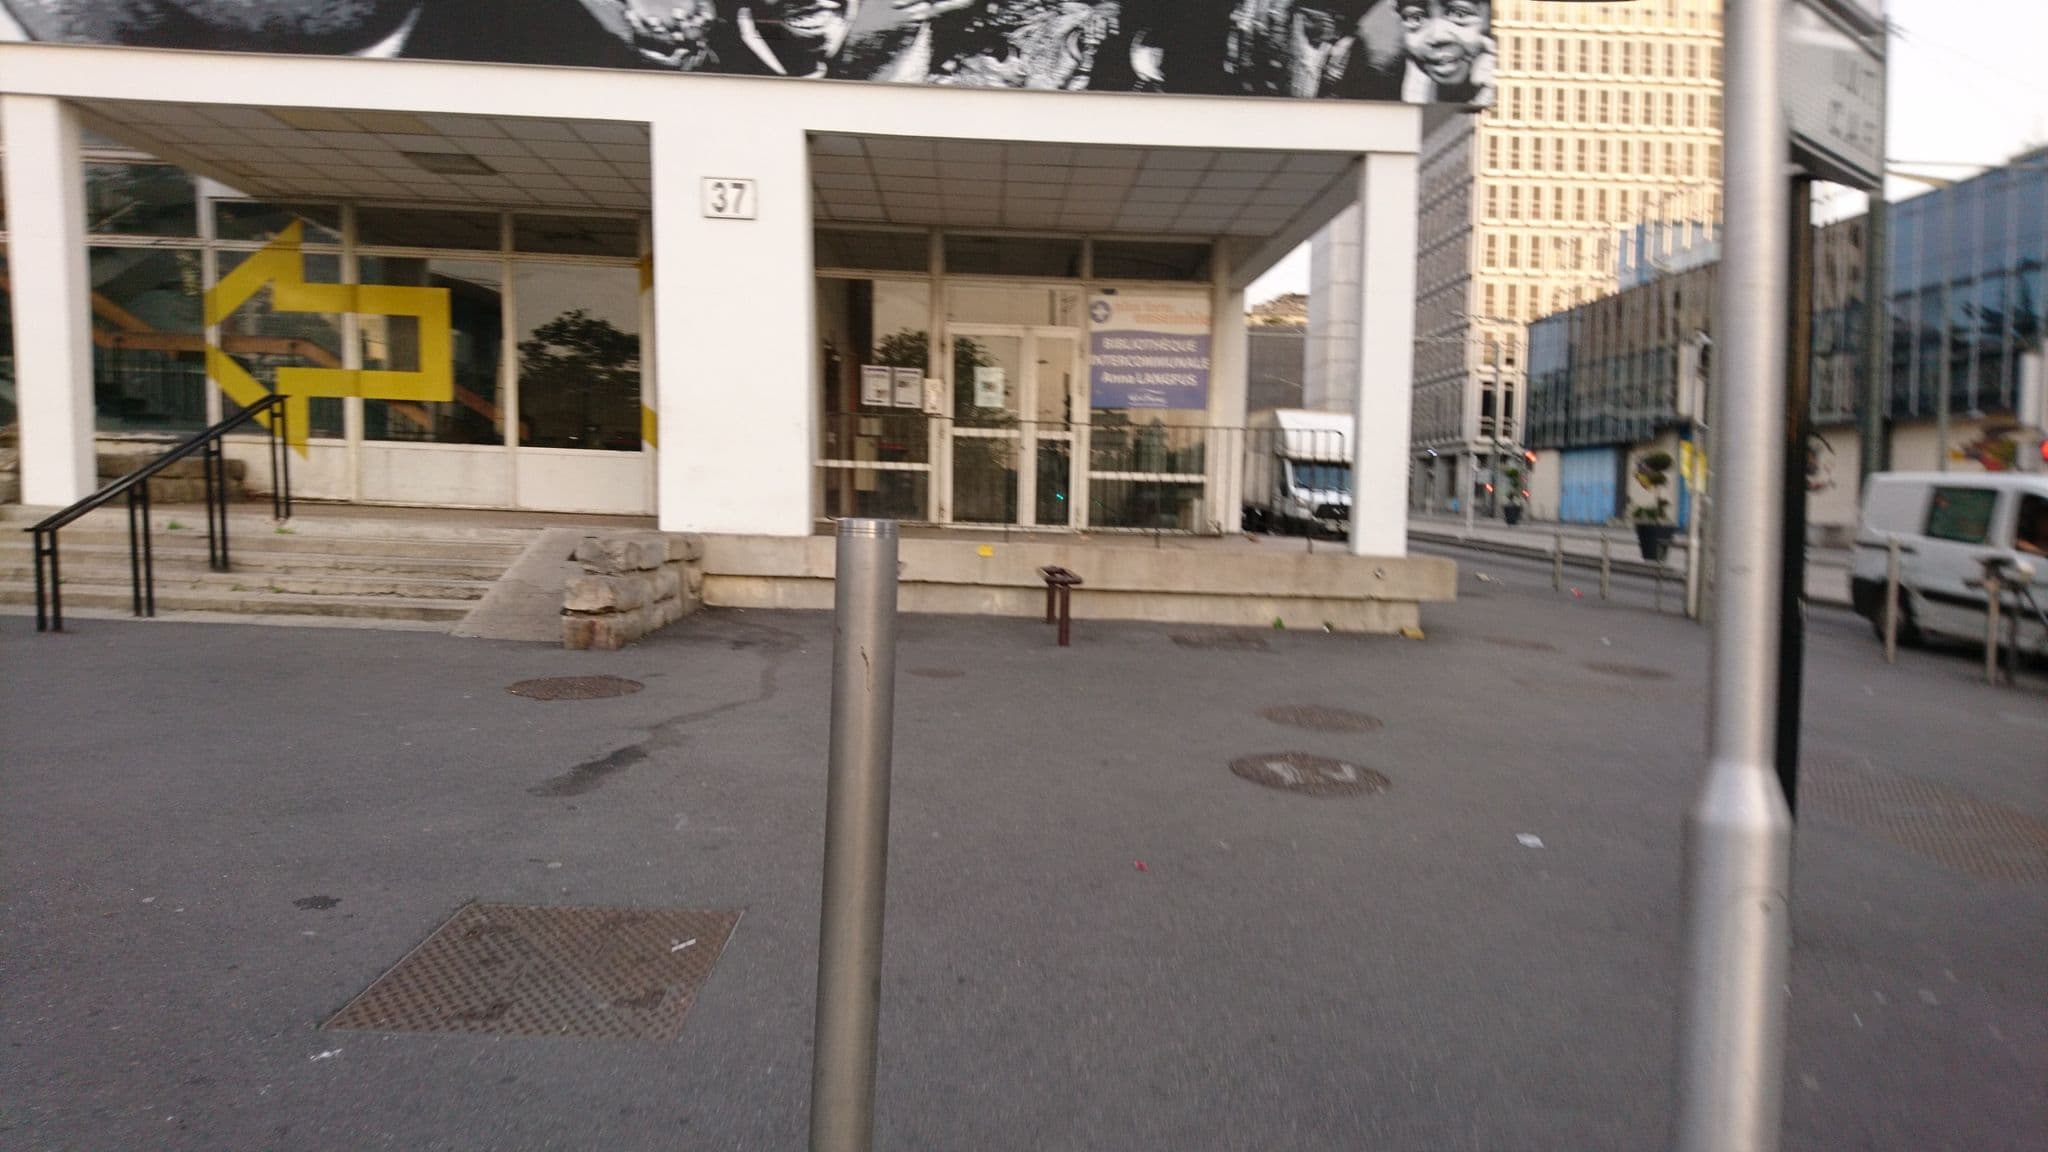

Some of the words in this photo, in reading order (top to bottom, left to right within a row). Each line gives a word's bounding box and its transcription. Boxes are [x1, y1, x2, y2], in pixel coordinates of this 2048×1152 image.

[711, 181, 745, 213] 37
[1090, 353, 1210, 370] INTERCOMMUNALE
[1102, 371, 1135, 384] Anna
[1136, 372, 1198, 386] LANGFUS
